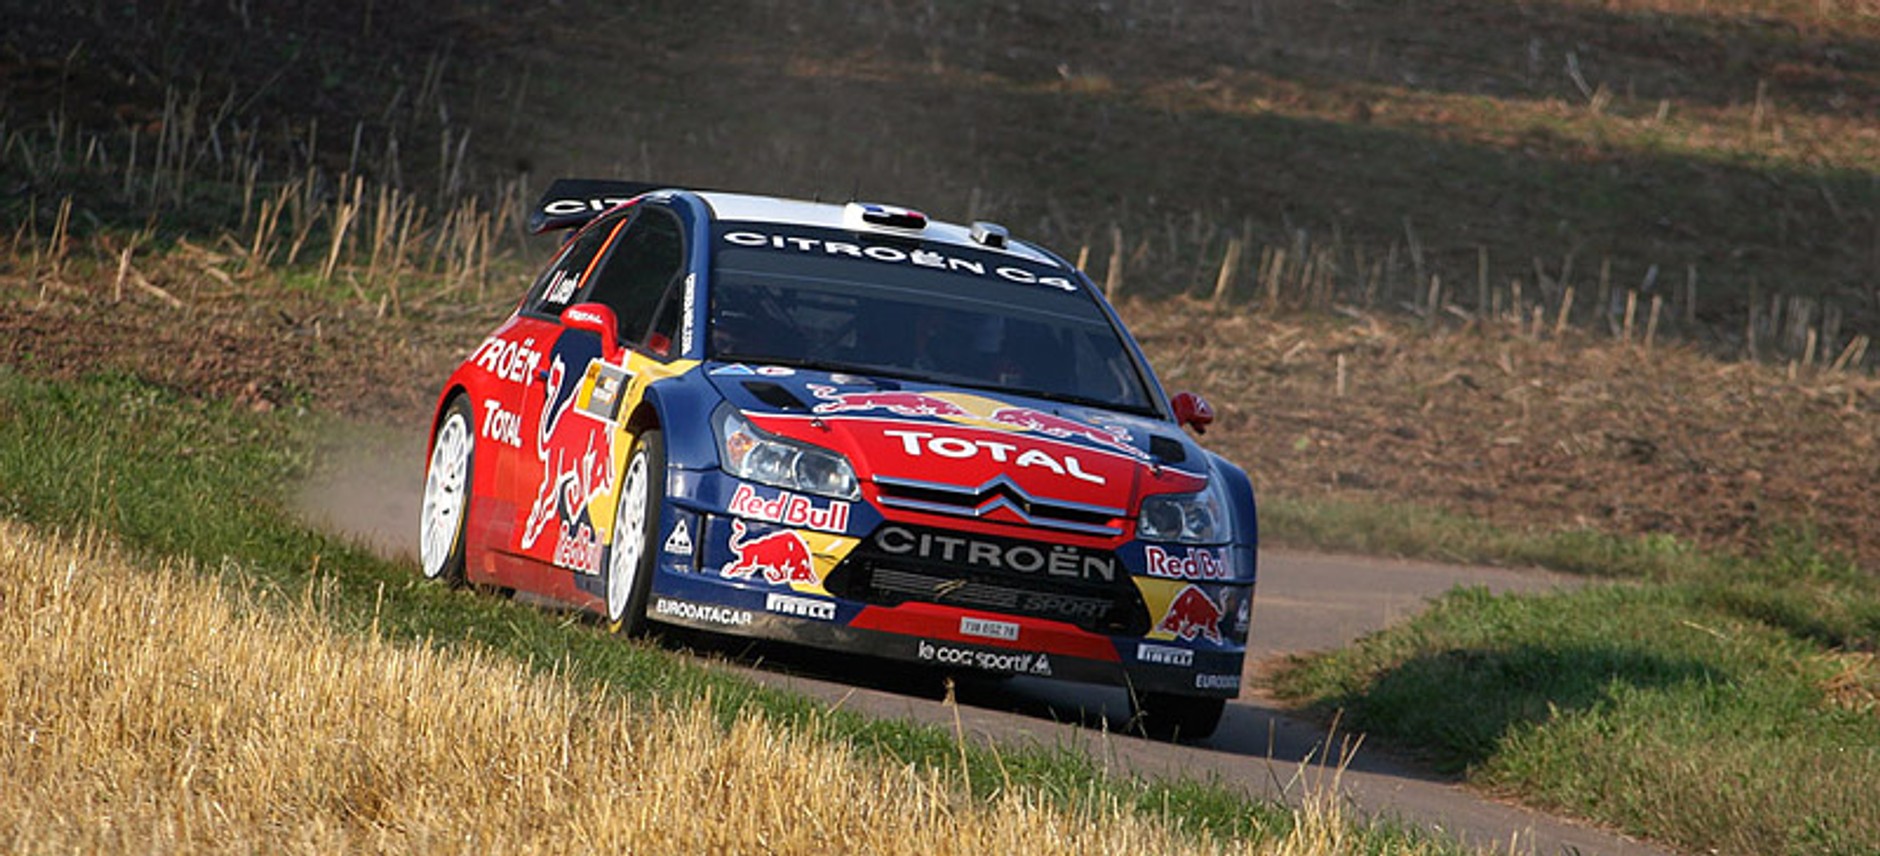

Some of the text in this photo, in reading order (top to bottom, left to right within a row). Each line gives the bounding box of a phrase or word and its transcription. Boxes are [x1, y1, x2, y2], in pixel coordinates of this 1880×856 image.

[723, 232, 1078, 291] CITROËN C4
[482, 398, 521, 448] TOTAL
[883, 430, 1106, 484] TOTAL
[729, 483, 850, 532] Red Bull
[875, 526, 1116, 582] CITROËN
[1145, 545, 1199, 579] Red
[656, 598, 753, 625] EURODATACAR
[766, 593, 836, 620] PIRELLI
[1022, 596, 1115, 619] SPORT
[918, 640, 935, 660] le
[975, 652, 1032, 672] sportif
[1137, 644, 1194, 666] PIRELLI
